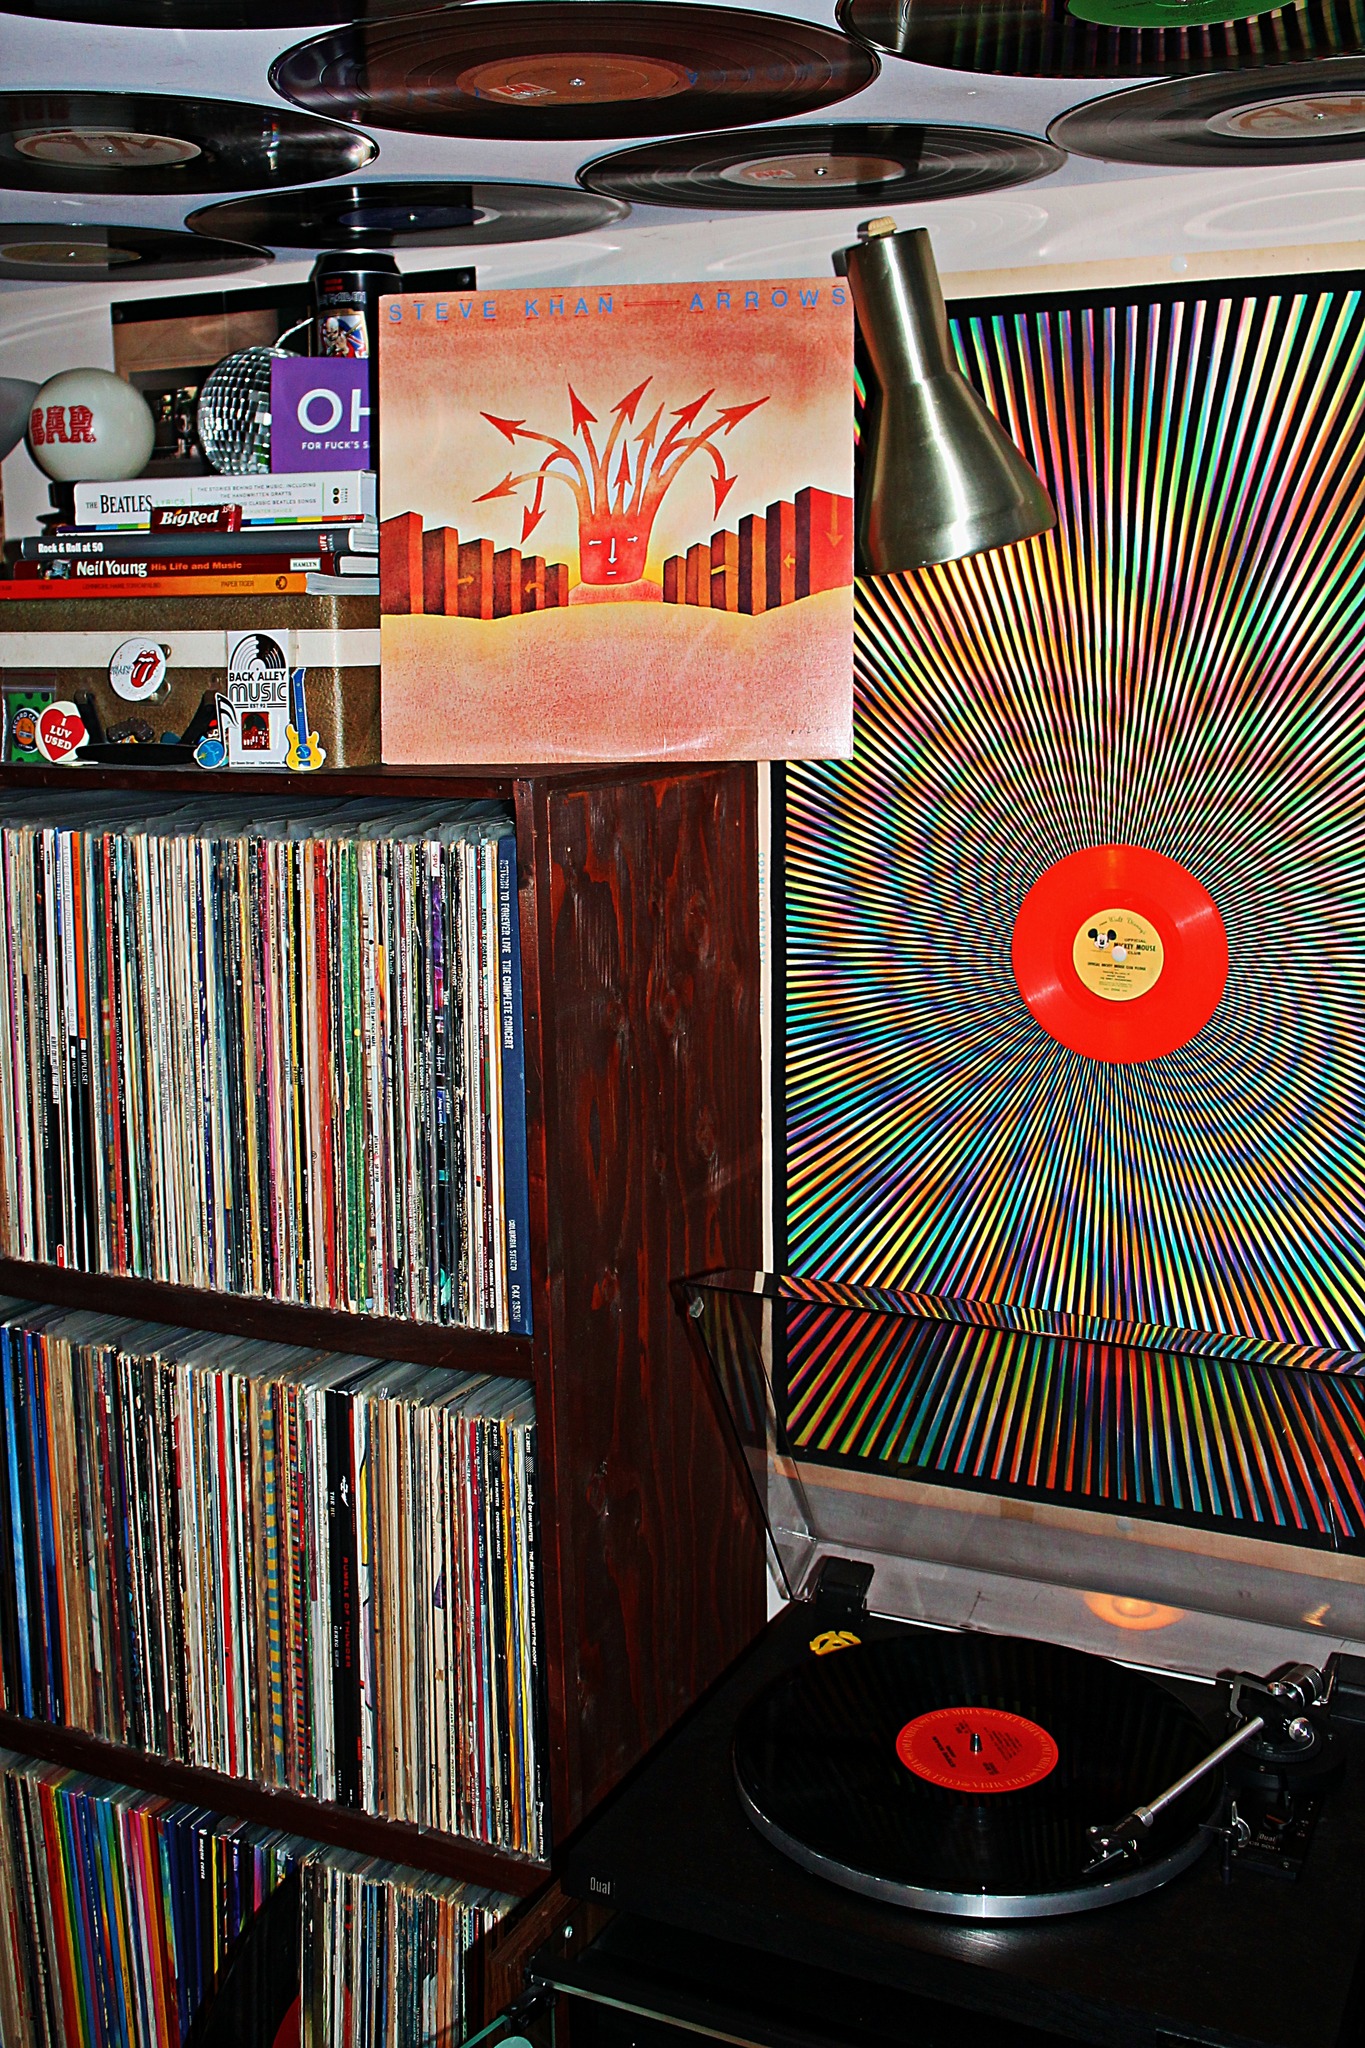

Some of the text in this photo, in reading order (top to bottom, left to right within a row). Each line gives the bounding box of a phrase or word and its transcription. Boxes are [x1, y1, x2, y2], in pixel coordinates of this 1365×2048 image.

[389, 288, 847, 321] STEVE KHAN ARROWS
[31, 405, 96, 446] BAR
[301, 440, 360, 450] FOR FUCK'S
[85, 501, 98, 509] THE
[99, 493, 152, 514] BEATLES
[38, 543, 57, 553] Rock
[65, 542, 81, 553] Roll
[82, 543, 91, 552] at
[92, 542, 104, 552] 50
[76, 561, 104, 576] Neil
[105, 560, 148, 577] Young
[151, 563, 167, 571] His
[169, 562, 189, 570] Life
[191, 562, 210, 570] and
[212, 561, 242, 569] Music
[229, 671, 287, 682] BACK ALLEY
[229, 682, 287, 702] MUSIC
[60, 717, 67, 727] I
[49, 725, 73, 739] LUV
[44, 734, 73, 750] USED
[482, 933, 487, 941] TO
[500, 860, 514, 1049] RETURN TO FOREVER LIVE THE COMPLETE CONCERT
[1136, 944, 1156, 952] MOUSE
[508, 1219, 517, 1271] COLUMBIA STEREO
[330, 1507, 335, 1517] HU
[344, 1603, 350, 1616] OF
[1259, 1833, 1276, 1842] Dual
[590, 1876, 611, 1895] Dual
